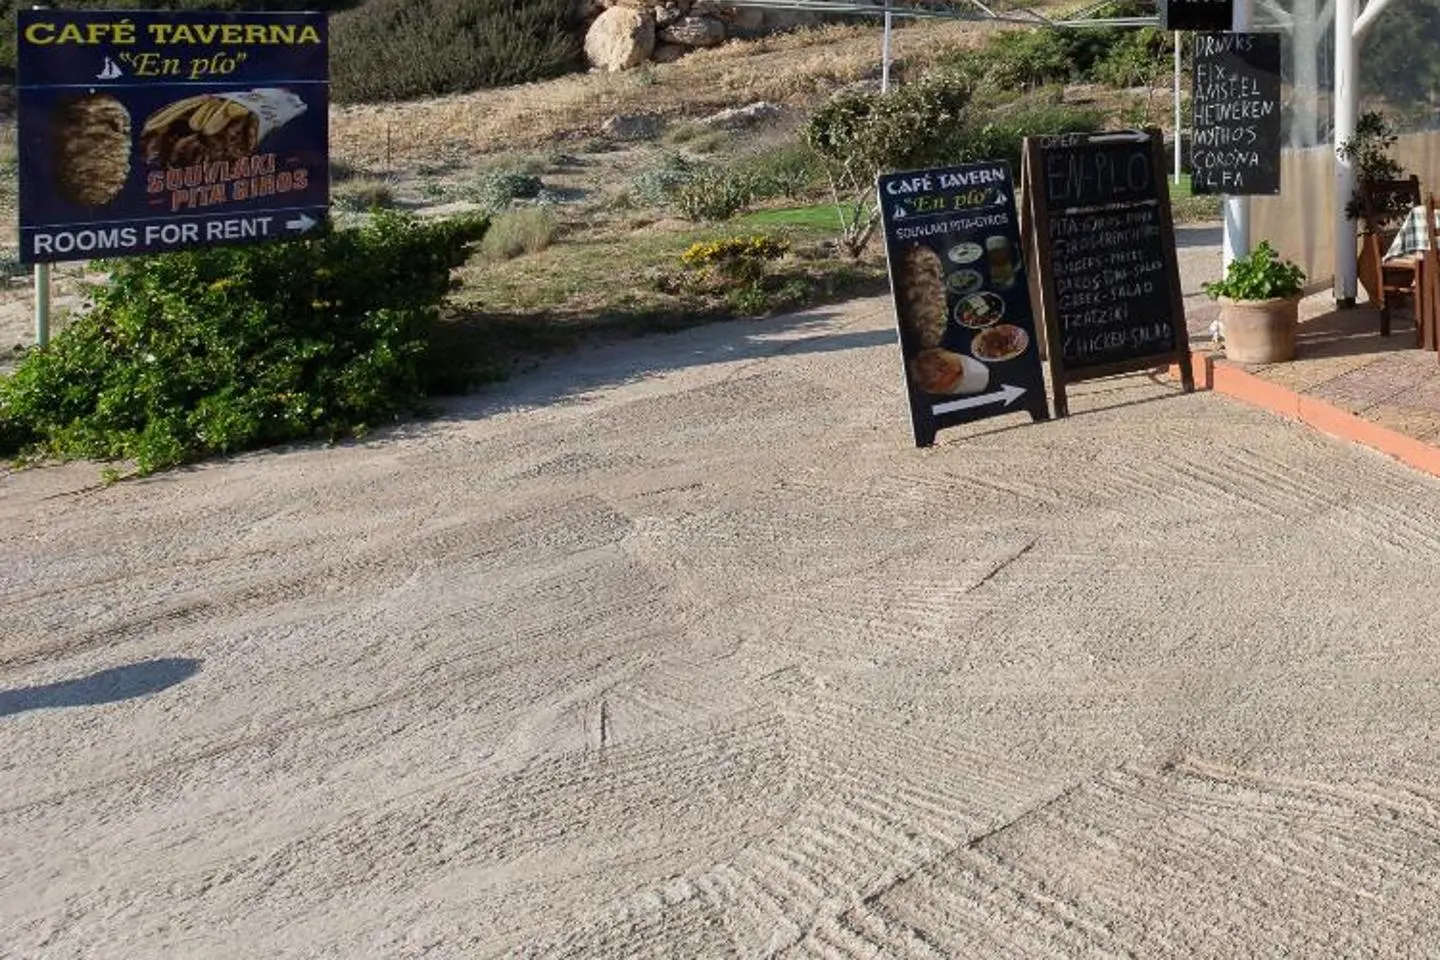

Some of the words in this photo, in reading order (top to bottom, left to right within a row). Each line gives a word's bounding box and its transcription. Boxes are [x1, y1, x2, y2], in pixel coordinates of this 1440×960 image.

[25, 19, 137, 45] CAFÉ
[148, 23, 321, 45] TAVERNA
[147, 153, 276, 192] SOUVLAKI
[171, 183, 227, 212] PITA
[233, 169, 309, 200] GIROS
[886, 174, 933, 195] CAFÉ
[938, 167, 1006, 189] TAVERN
[34, 227, 137, 254] ROOMS
[145, 222, 199, 245] FOR
[206, 217, 273, 240] RENT
